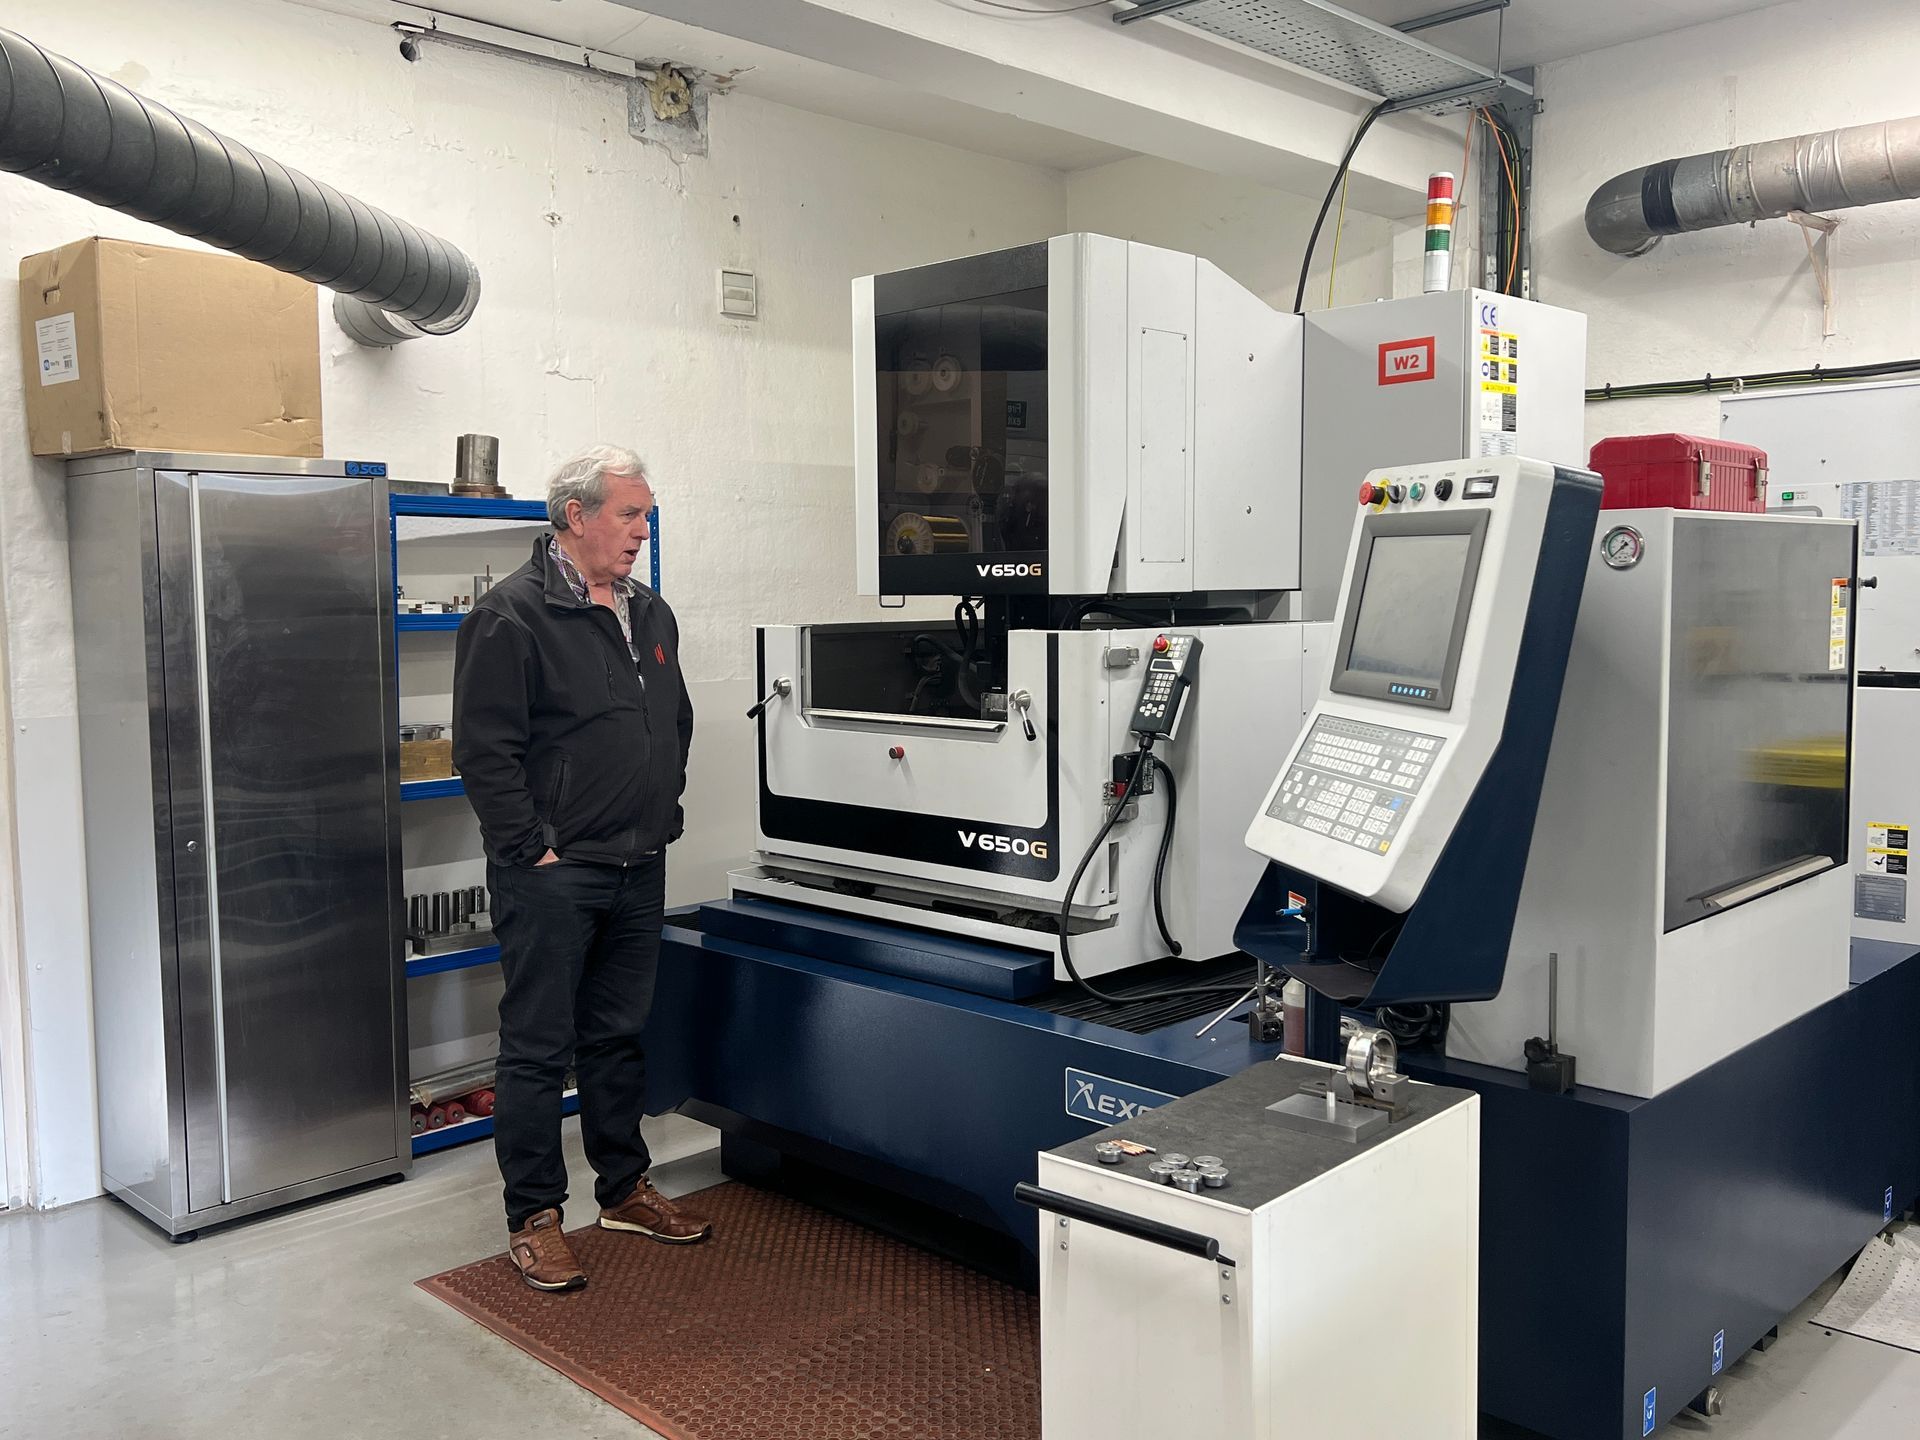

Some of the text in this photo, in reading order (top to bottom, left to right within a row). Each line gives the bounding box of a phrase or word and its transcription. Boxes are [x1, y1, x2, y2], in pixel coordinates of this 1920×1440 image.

[1394, 354, 1419, 370] W2
[976, 563, 1042, 577] V650G
[957, 830, 1047, 859] V650G
